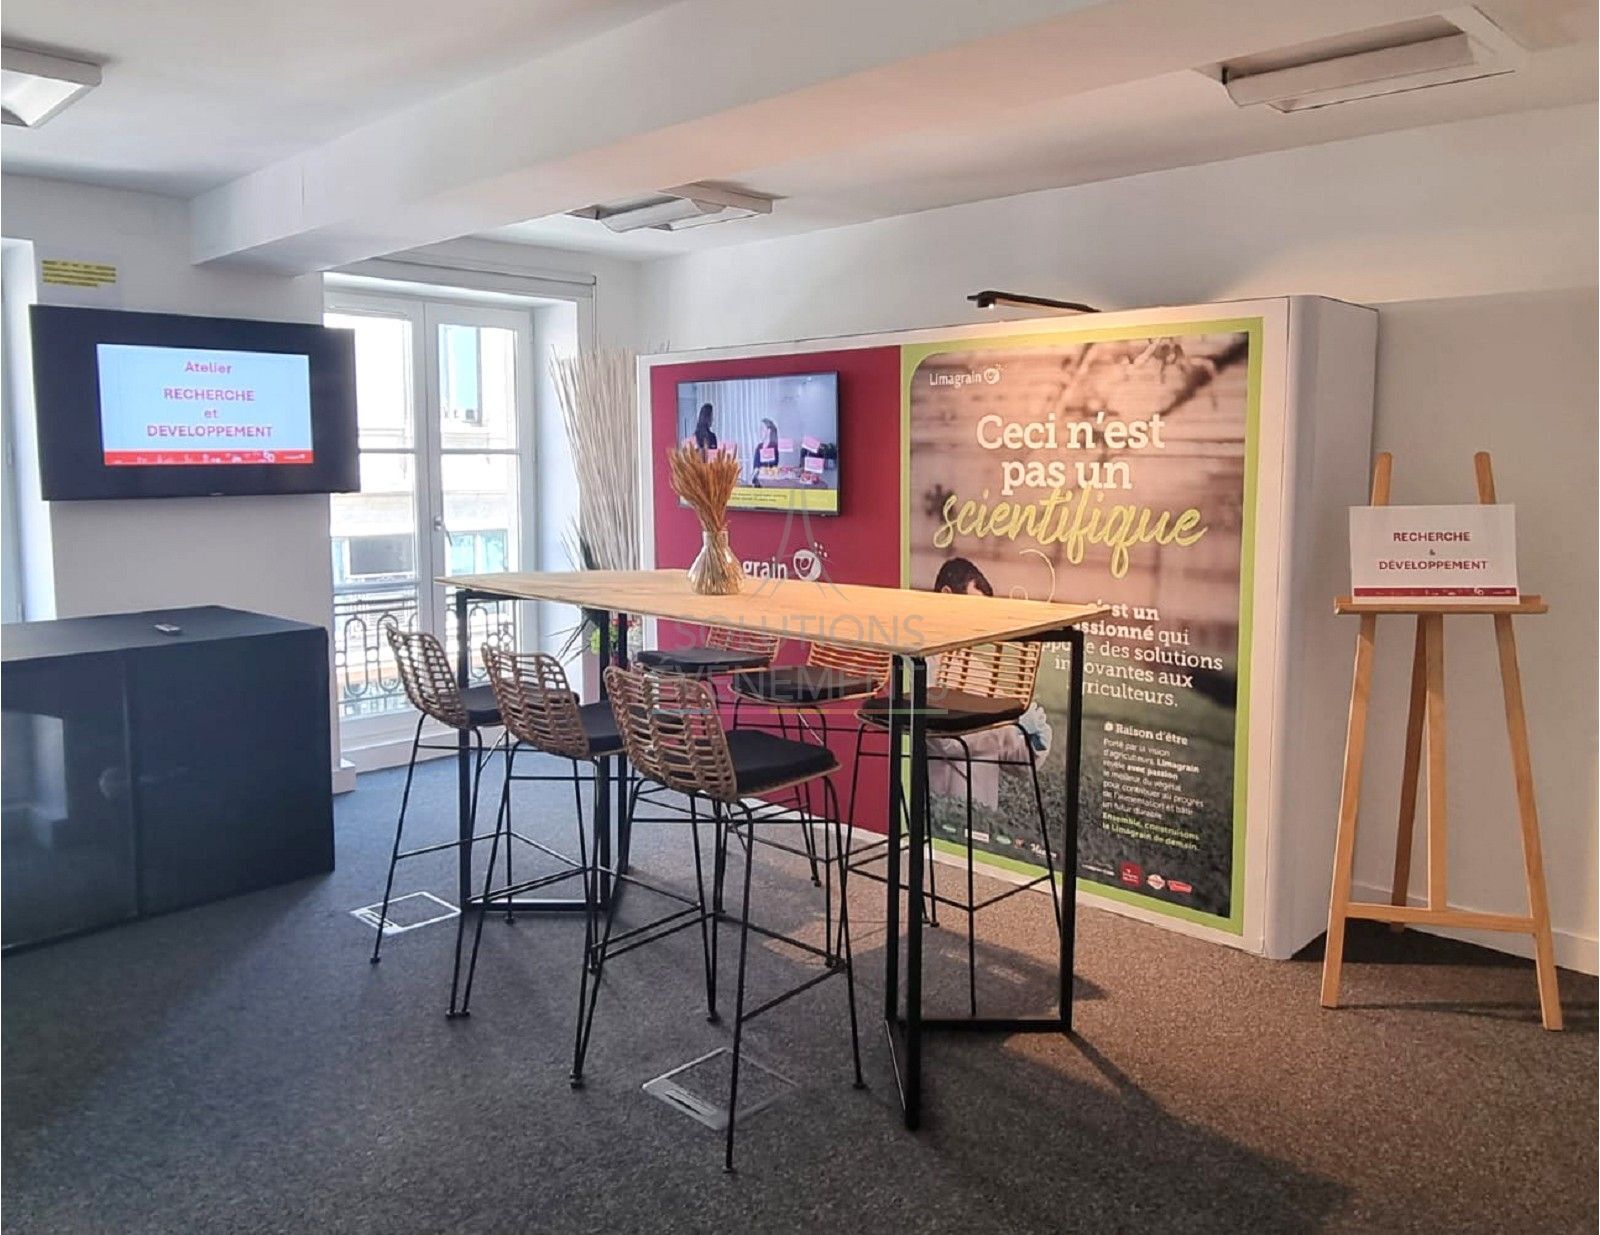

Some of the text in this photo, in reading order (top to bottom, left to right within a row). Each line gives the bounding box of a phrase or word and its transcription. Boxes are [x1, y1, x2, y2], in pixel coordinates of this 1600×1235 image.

[185, 361, 232, 374] Atelier
[929, 370, 982, 389] Limagrain
[163, 387, 256, 402] RECHERCHE
[204, 408, 219, 419] et
[146, 424, 273, 438] DEVELOPPEMENT
[976, 411, 1166, 450] Ceci n'est
[1001, 459, 1133, 496] pas un
[933, 486, 1208, 580] scientifique
[1392, 531, 1472, 542] RECHERCHE
[742, 556, 788, 580] grain
[1133, 605, 1160, 621] un
[1072, 620, 1190, 647] ssionné qui
[1100, 640, 1130, 658] des
[1134, 646, 1223, 671] solutions
[1055, 655, 1193, 689] inovantes aux
[1082, 680, 1178, 708] riculteurs.
[1115, 723, 1188, 745] Raison d'être
[1147, 768, 1178, 780] passion
[1156, 758, 1199, 773] Limagrain
